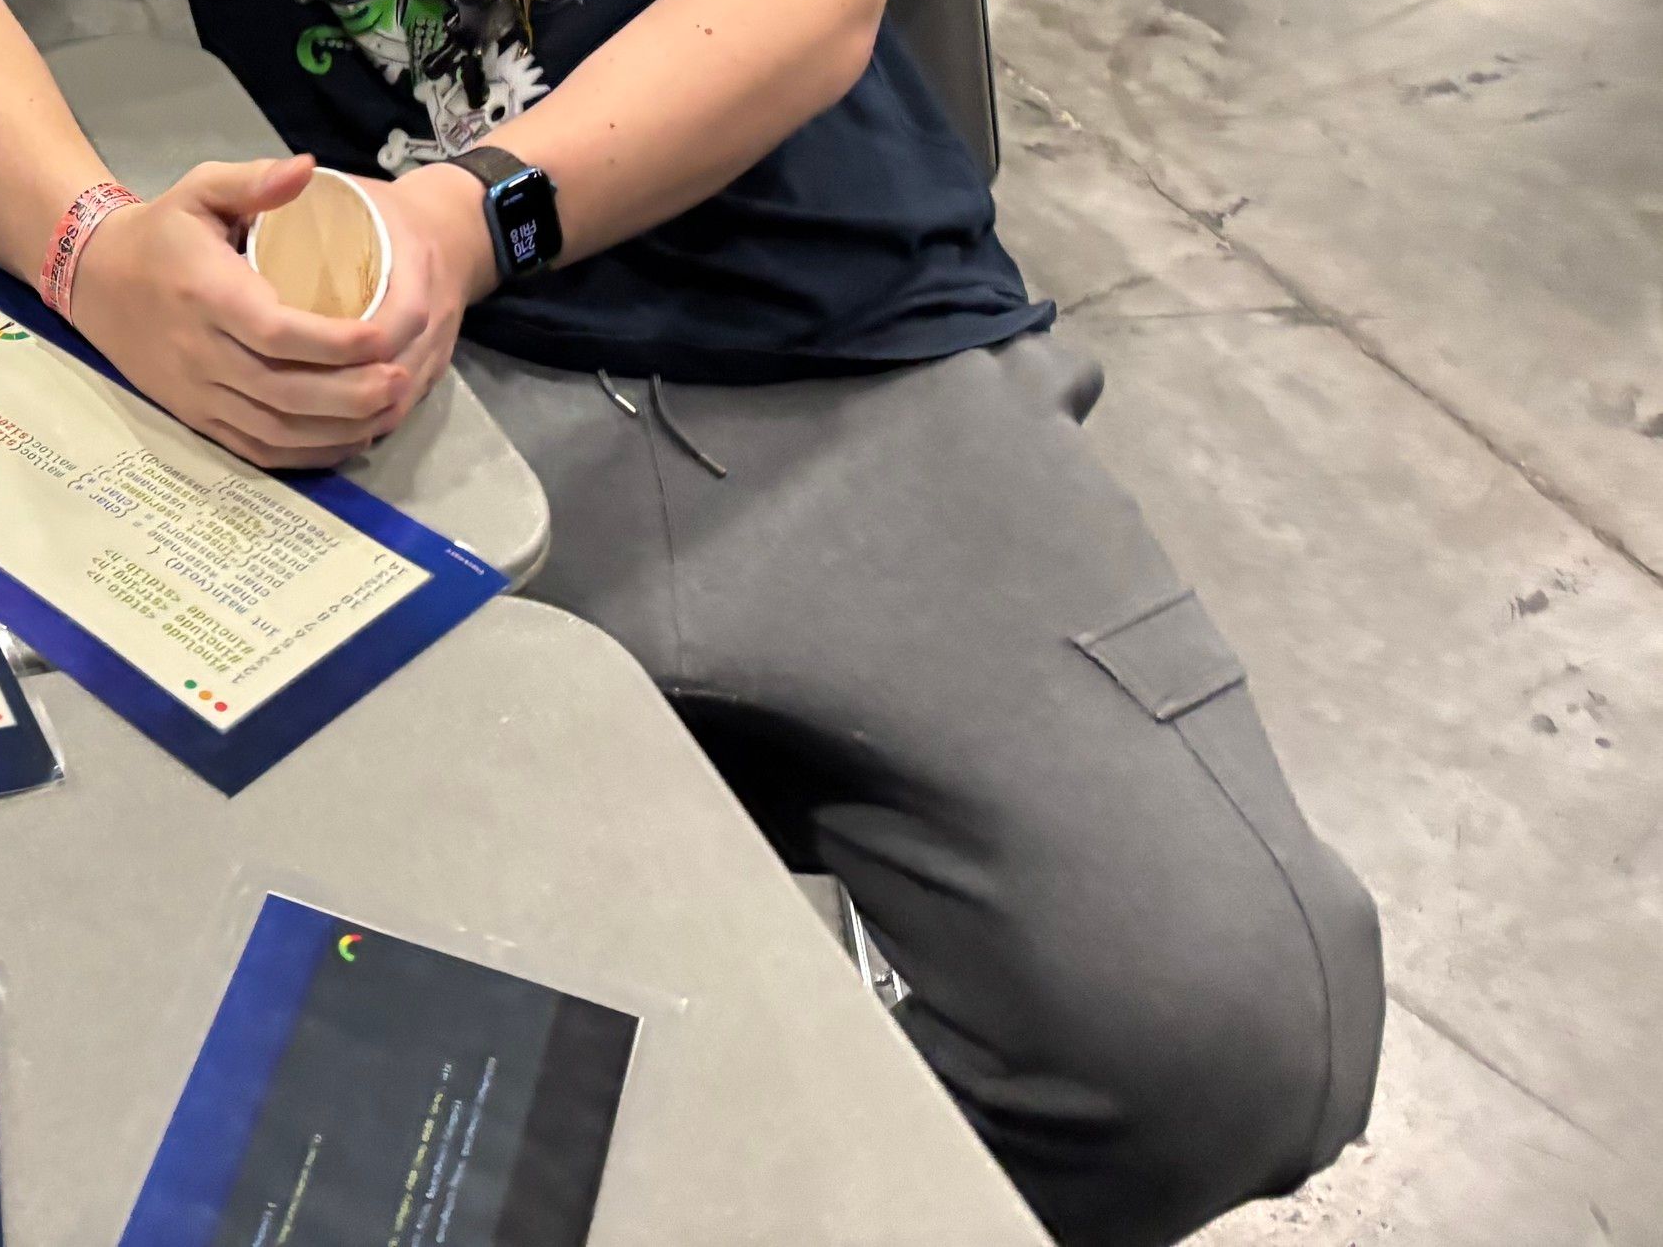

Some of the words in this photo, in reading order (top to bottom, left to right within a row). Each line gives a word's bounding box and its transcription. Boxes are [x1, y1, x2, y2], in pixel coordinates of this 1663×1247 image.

[509, 229, 519, 244] 8
[519, 219, 537, 240] FRI
[162, 556, 249, 615] main(void)
[220, 579, 261, 607] char
[232, 571, 273, 598] char
[170, 613, 244, 664] #include
[182, 604, 256, 655] #include
[247, 614, 281, 637] int
[158, 621, 232, 673] #include
